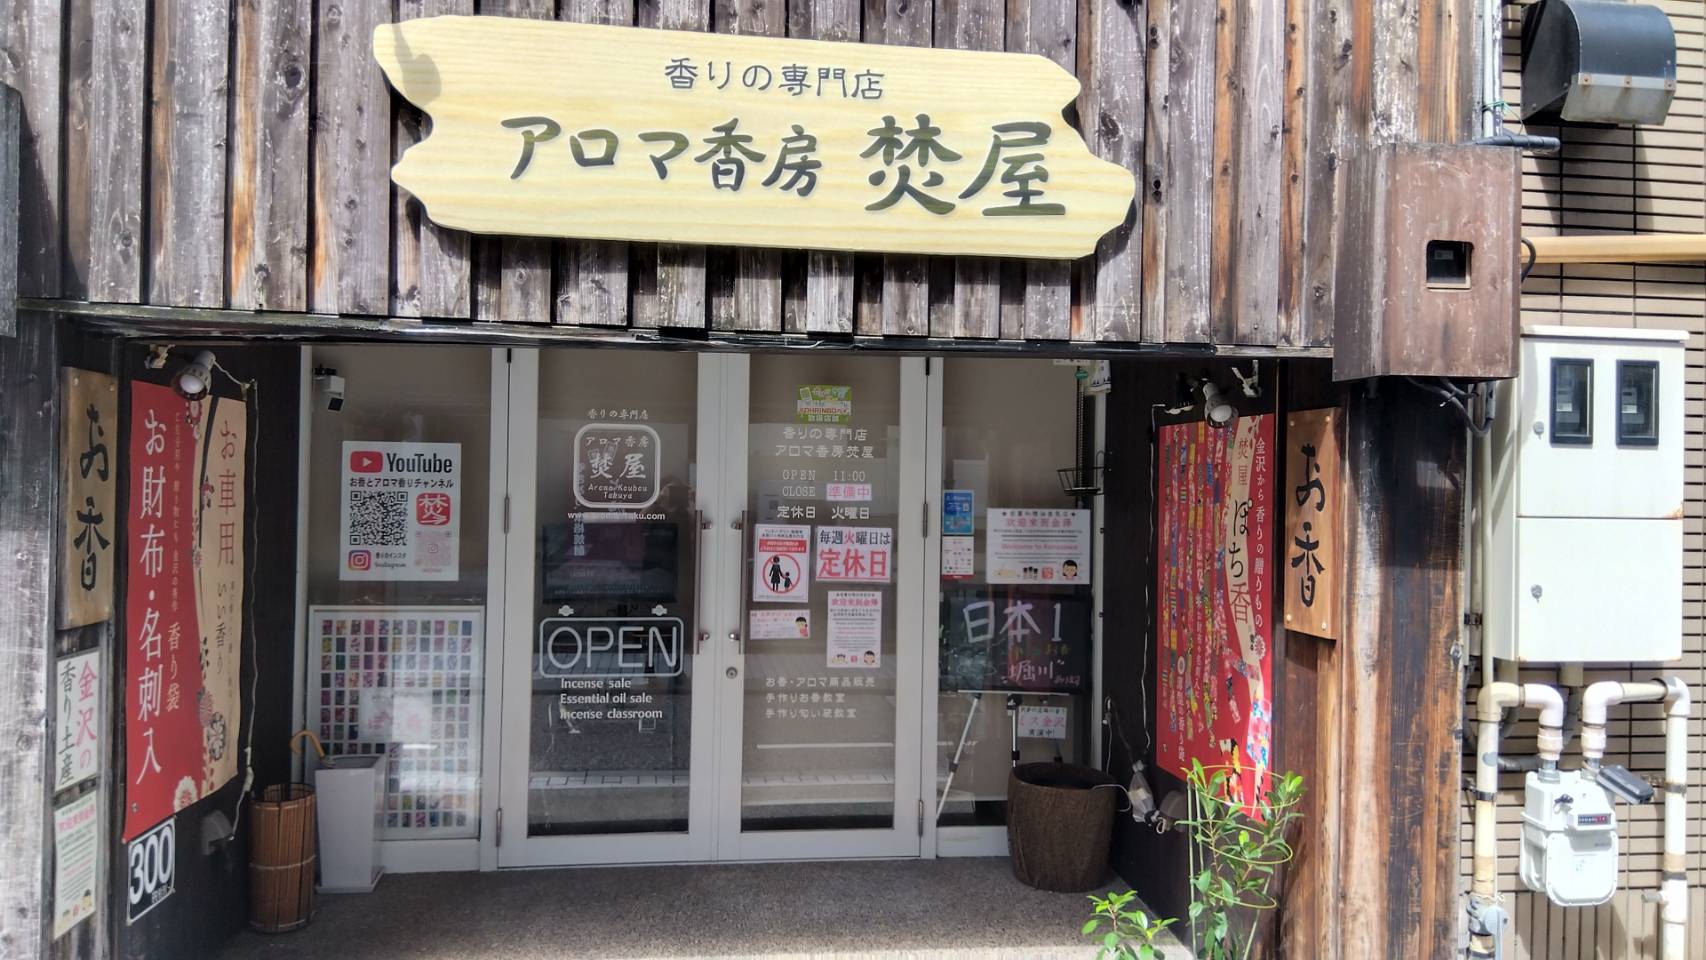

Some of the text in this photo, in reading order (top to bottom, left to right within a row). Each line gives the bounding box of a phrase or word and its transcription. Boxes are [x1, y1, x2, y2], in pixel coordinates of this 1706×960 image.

[664, 57, 885, 101] 香りの専門店
[500, 114, 1067, 217] アロマ香房 焚屋
[586, 435, 649, 448] アロマ香房
[783, 426, 868, 441] 香りの専門店
[386, 452, 453, 474] YouTube
[589, 452, 647, 479] 焚屋
[775, 445, 874, 459] アロマ香房焚屋
[1237, 437, 1249, 486] 焚屋
[350, 477, 454, 489] お香とアロマ香りチャンネル
[782, 470, 866, 482] OPEN 11:00
[73, 403, 111, 593] お香
[216, 420, 238, 566] お車用
[828, 485, 870, 499] 準備中
[776, 505, 870, 519] 定休日 火曜日
[1291, 443, 1326, 608] お香
[819, 529, 891, 546] 毎週火曜日は
[818, 549, 888, 578] 定休日
[1228, 498, 1253, 624] ぽち香
[136, 409, 167, 785] お財布・名刺入
[962, 600, 1062, 643] 日本1
[547, 626, 678, 669] OPEN
[166, 622, 181, 712] 香り袋
[560, 678, 632, 689] Incense sale
[766, 677, 875, 688] お香・アロマ商品販売
[560, 692, 653, 704] Essential oil sale
[765, 693, 846, 704] 手作りお香教室
[58, 661, 76, 785] 香り土産
[75, 661, 97, 769] 金沢の
[560, 708, 663, 720] Incense classroom
[129, 825, 173, 905] 300
